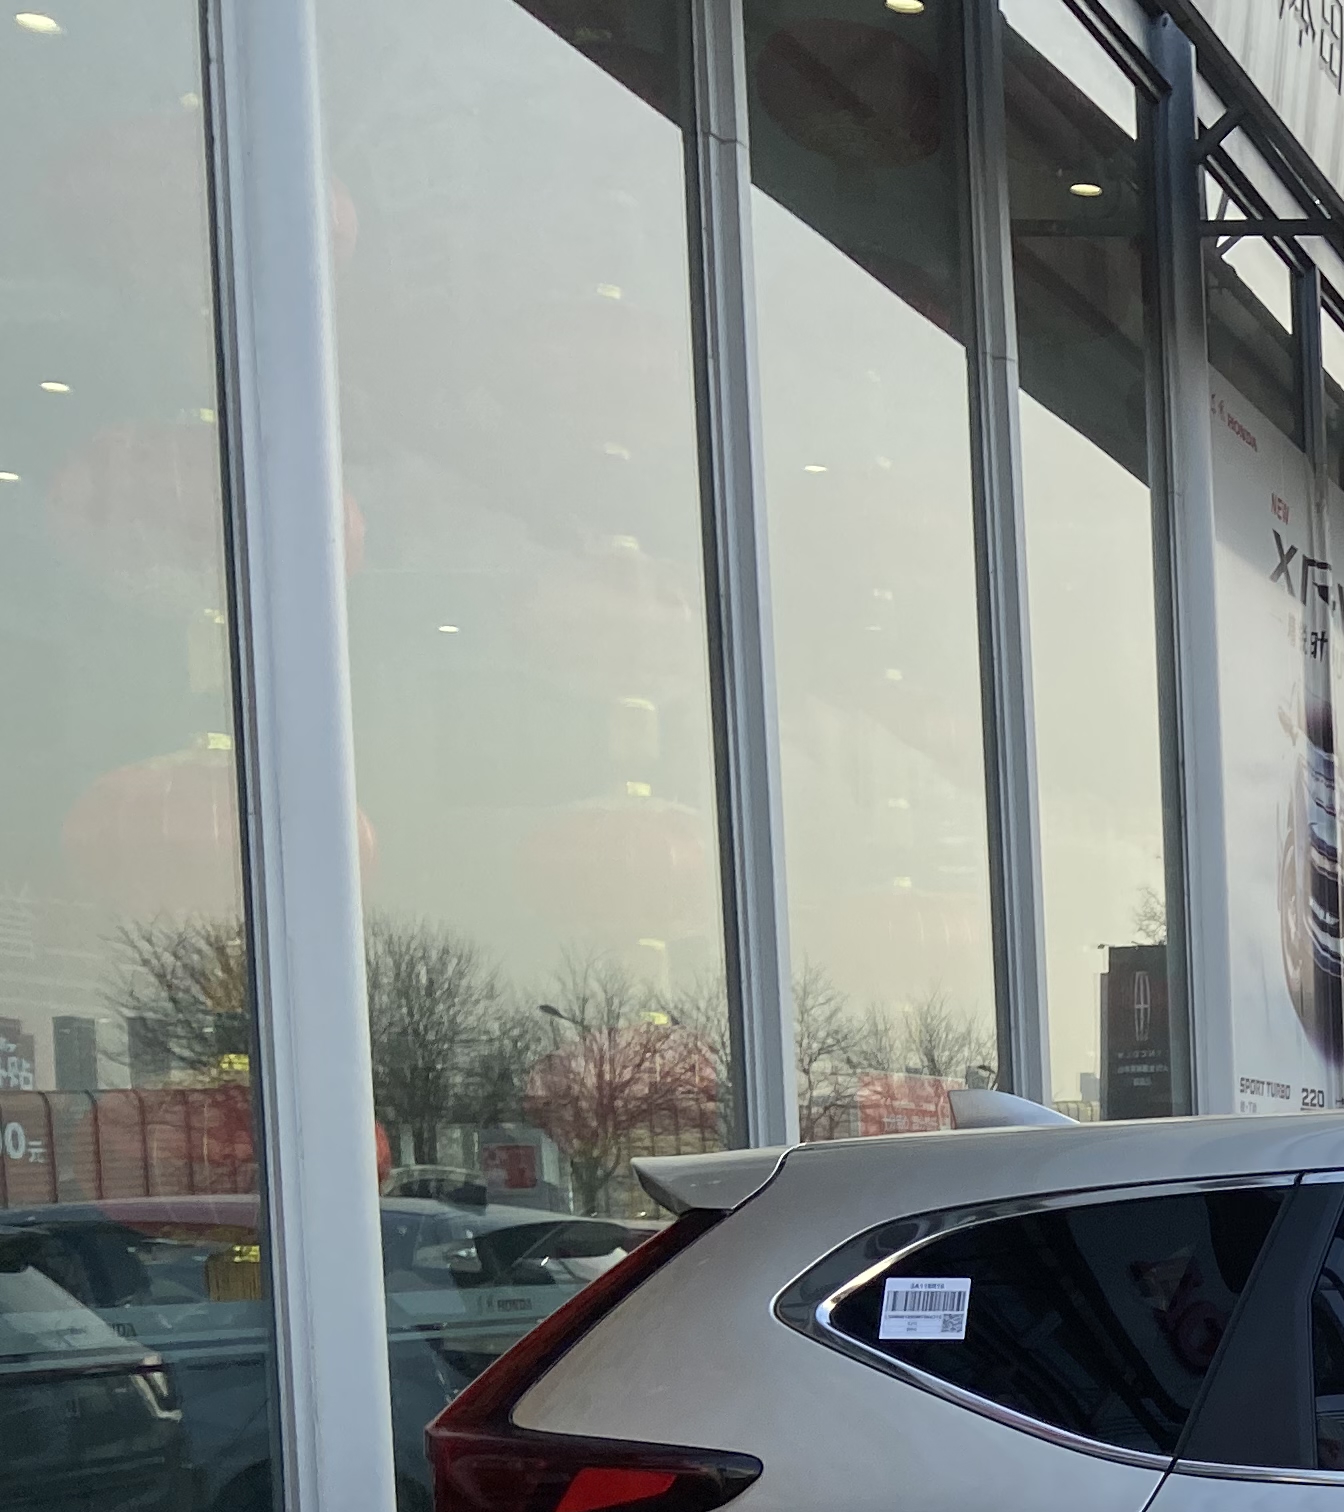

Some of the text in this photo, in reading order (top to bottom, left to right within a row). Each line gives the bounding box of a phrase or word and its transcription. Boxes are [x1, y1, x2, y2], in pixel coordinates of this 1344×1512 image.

[1271, 492, 1290, 525] NEW
[1239, 1077, 1291, 1100] SPORT TURBO
[1301, 1088, 1325, 1108] 220
